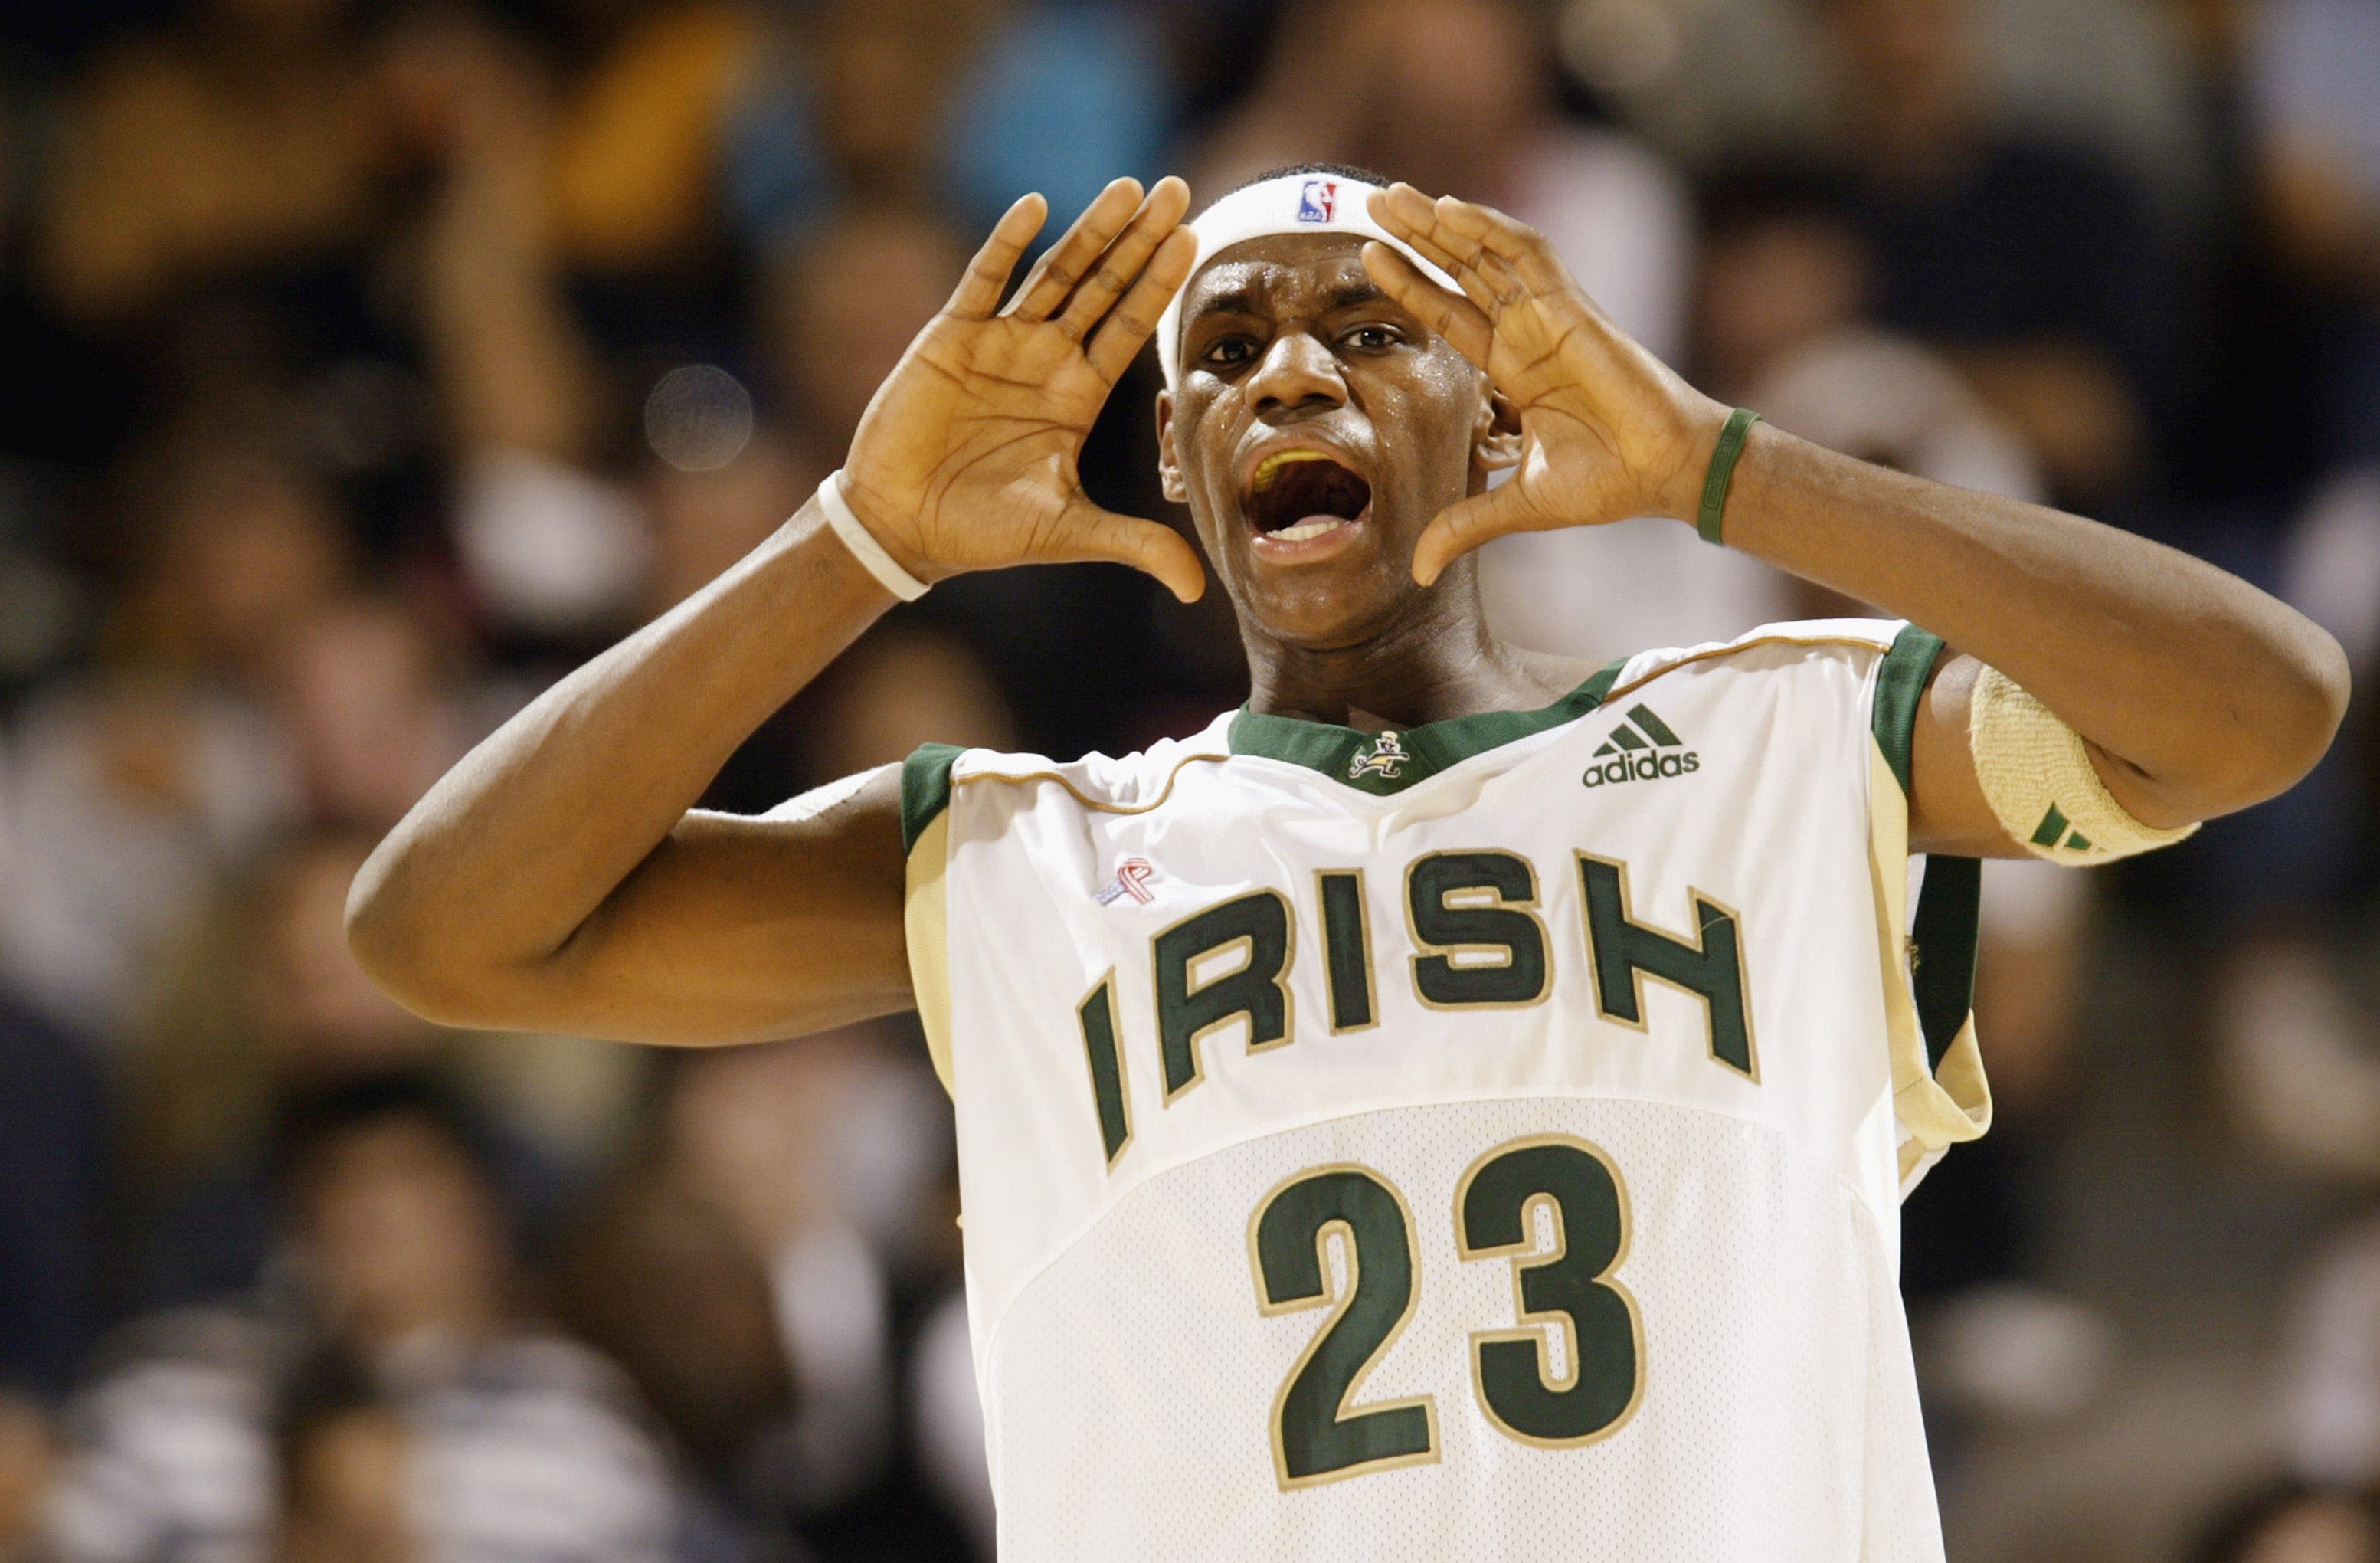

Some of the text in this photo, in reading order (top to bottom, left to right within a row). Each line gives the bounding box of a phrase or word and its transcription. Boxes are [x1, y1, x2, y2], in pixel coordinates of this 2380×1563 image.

[1582, 749, 1700, 788] adidas
[1075, 848, 1762, 1176] IRISH
[1246, 1132, 1648, 1493] 23
